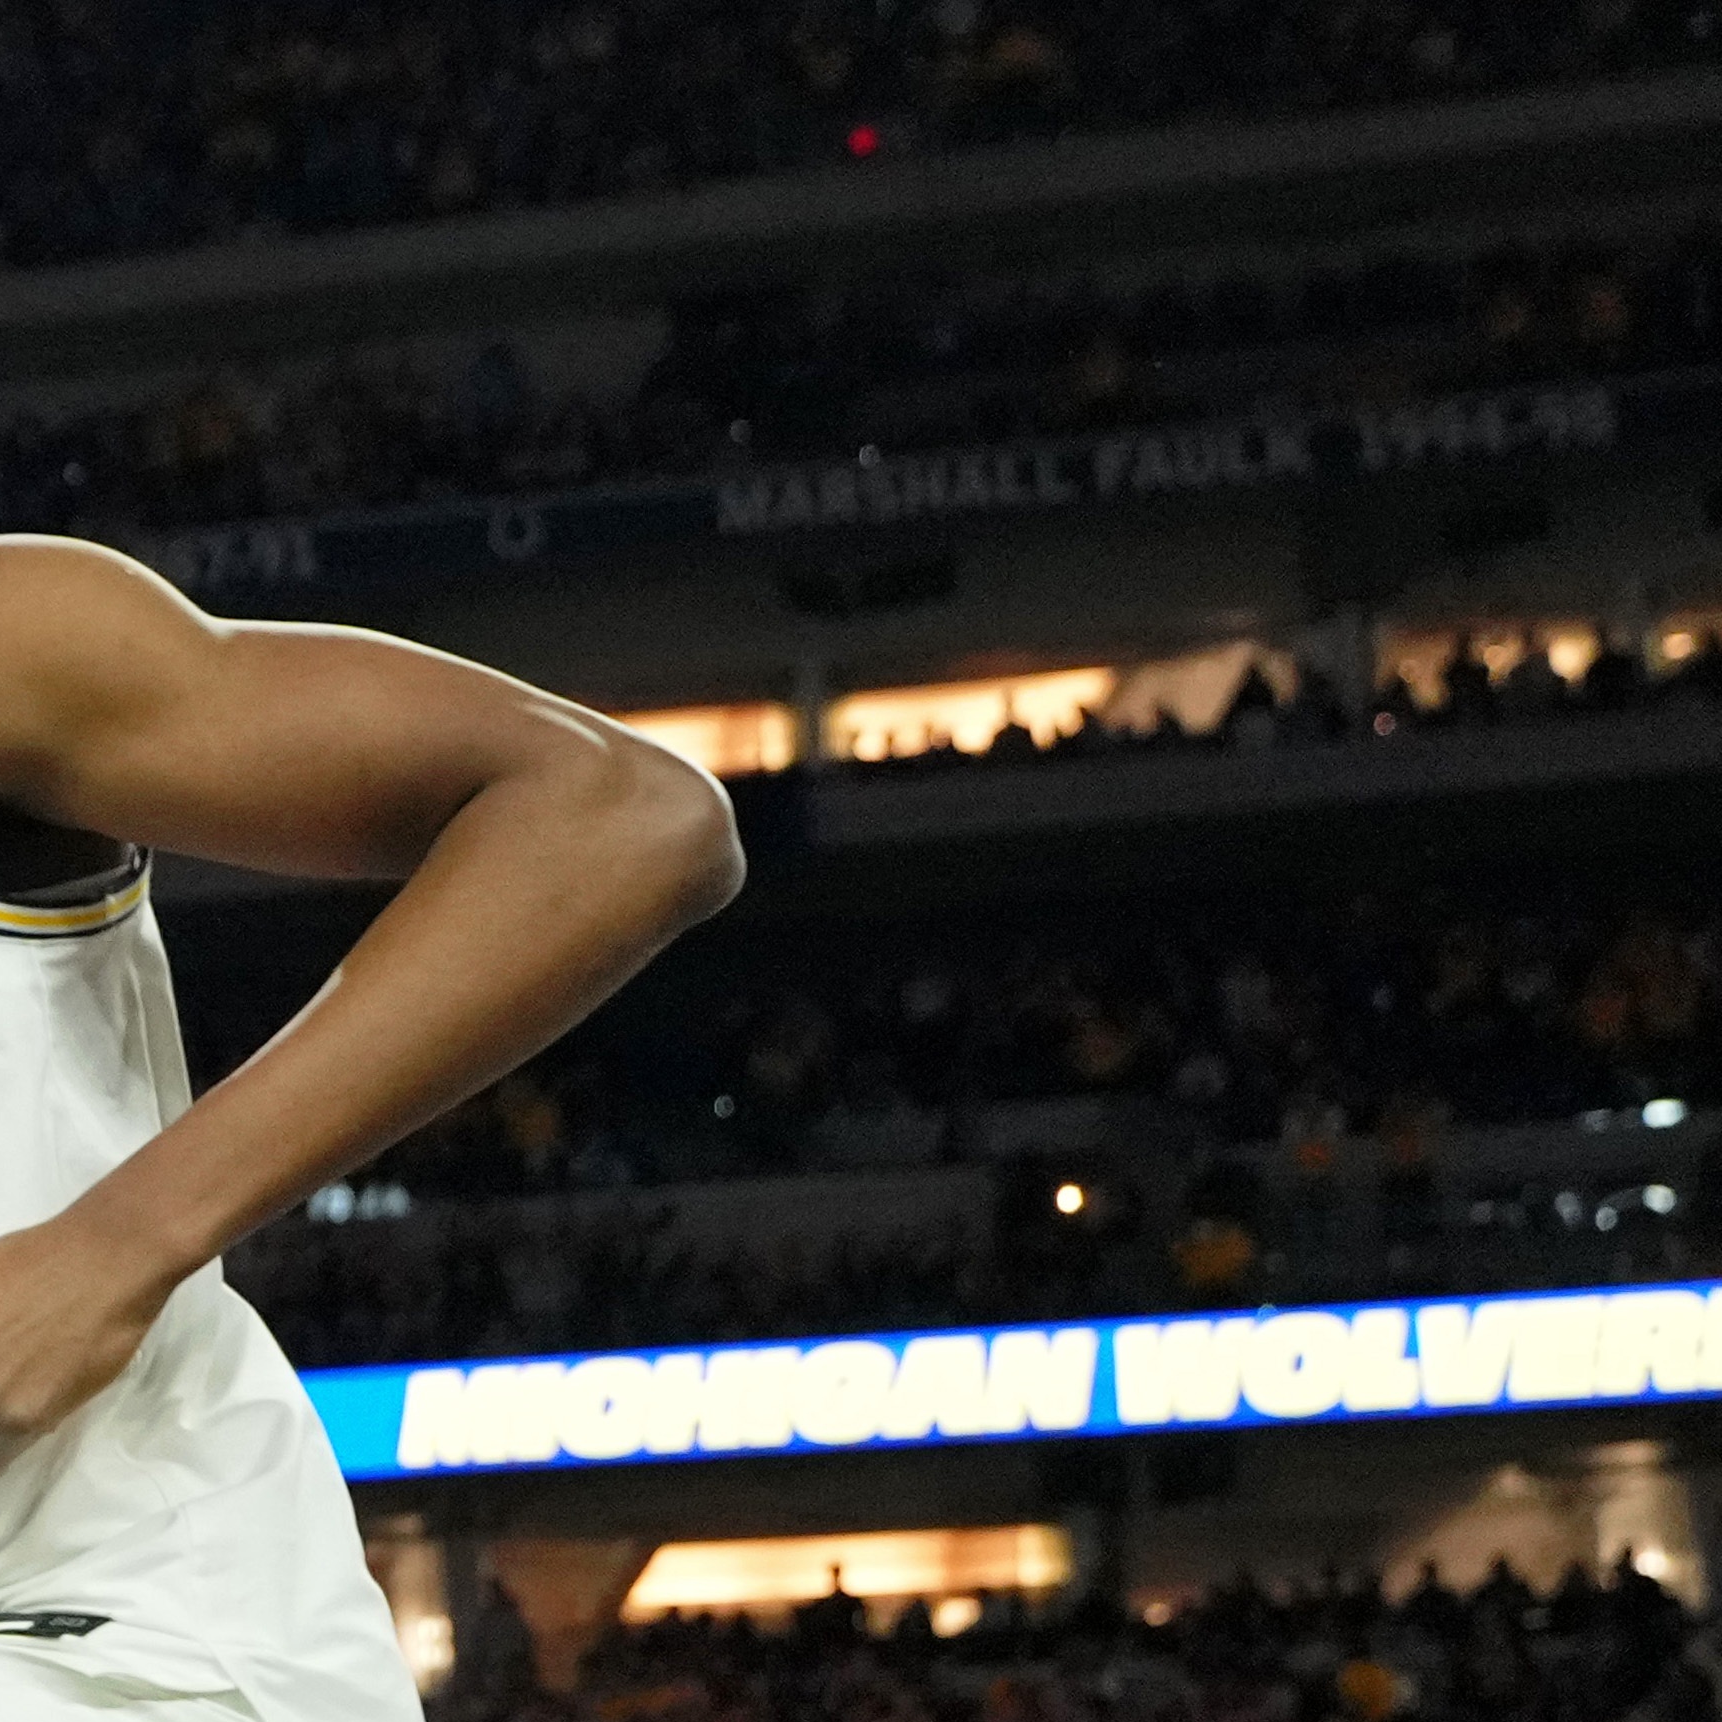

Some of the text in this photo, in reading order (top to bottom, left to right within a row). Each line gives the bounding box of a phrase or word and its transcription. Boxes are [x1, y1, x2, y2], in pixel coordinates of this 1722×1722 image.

[718, 450, 1075, 532] MARSHALL
[1093, 425, 1309, 493] FAULK
[397, 1327, 1097, 1468] MICHIGAN
